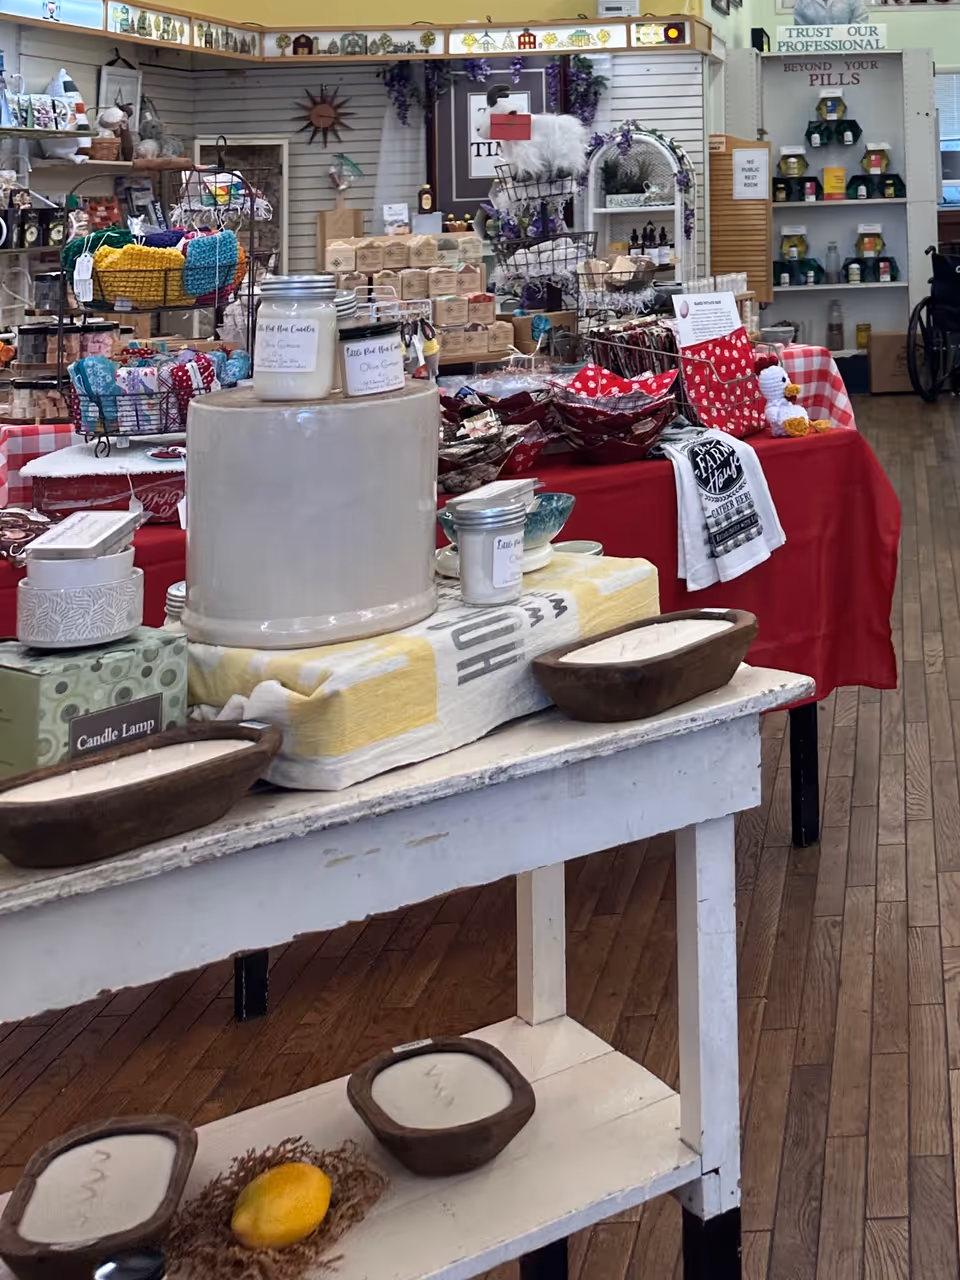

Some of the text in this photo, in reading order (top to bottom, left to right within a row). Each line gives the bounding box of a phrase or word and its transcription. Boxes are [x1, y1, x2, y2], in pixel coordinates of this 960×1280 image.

[785, 26, 879, 38] TRUST OUR
[777, 39, 885, 51] PROFESSIONAL
[784, 61, 879, 72] BEYOND YOUR
[809, 73, 860, 86] PILLS
[696, 441, 733, 479] FARM
[711, 501, 735, 519] GATHER
[77, 717, 155, 751] Candle Lamp
